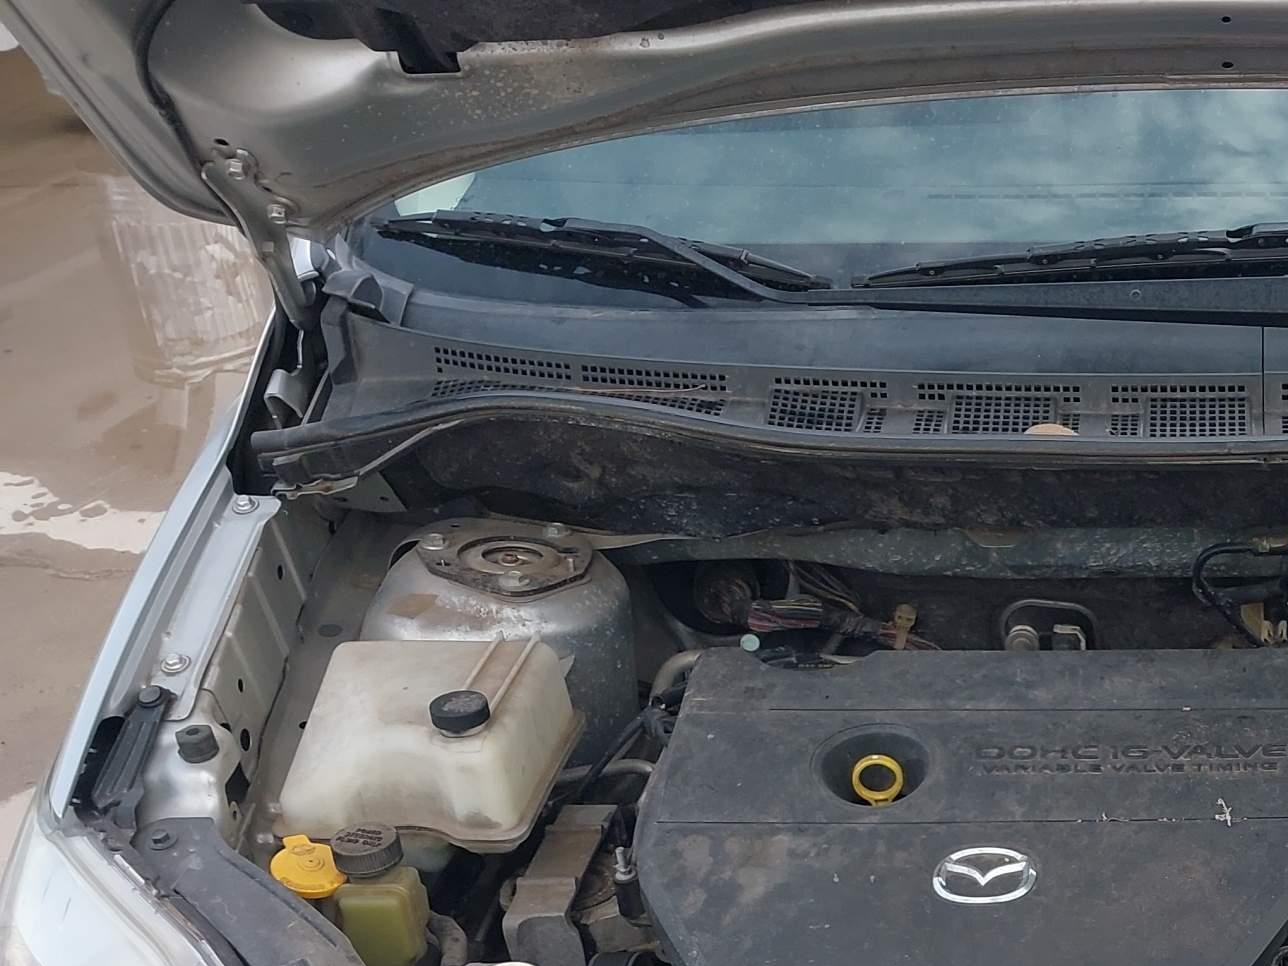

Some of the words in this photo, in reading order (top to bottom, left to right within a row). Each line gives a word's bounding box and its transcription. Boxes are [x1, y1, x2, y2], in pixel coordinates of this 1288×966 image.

[980, 763, 1103, 775] VARIABLE
[1110, 763, 1185, 774] VALVE
[1192, 761, 1278, 773] TIMING
